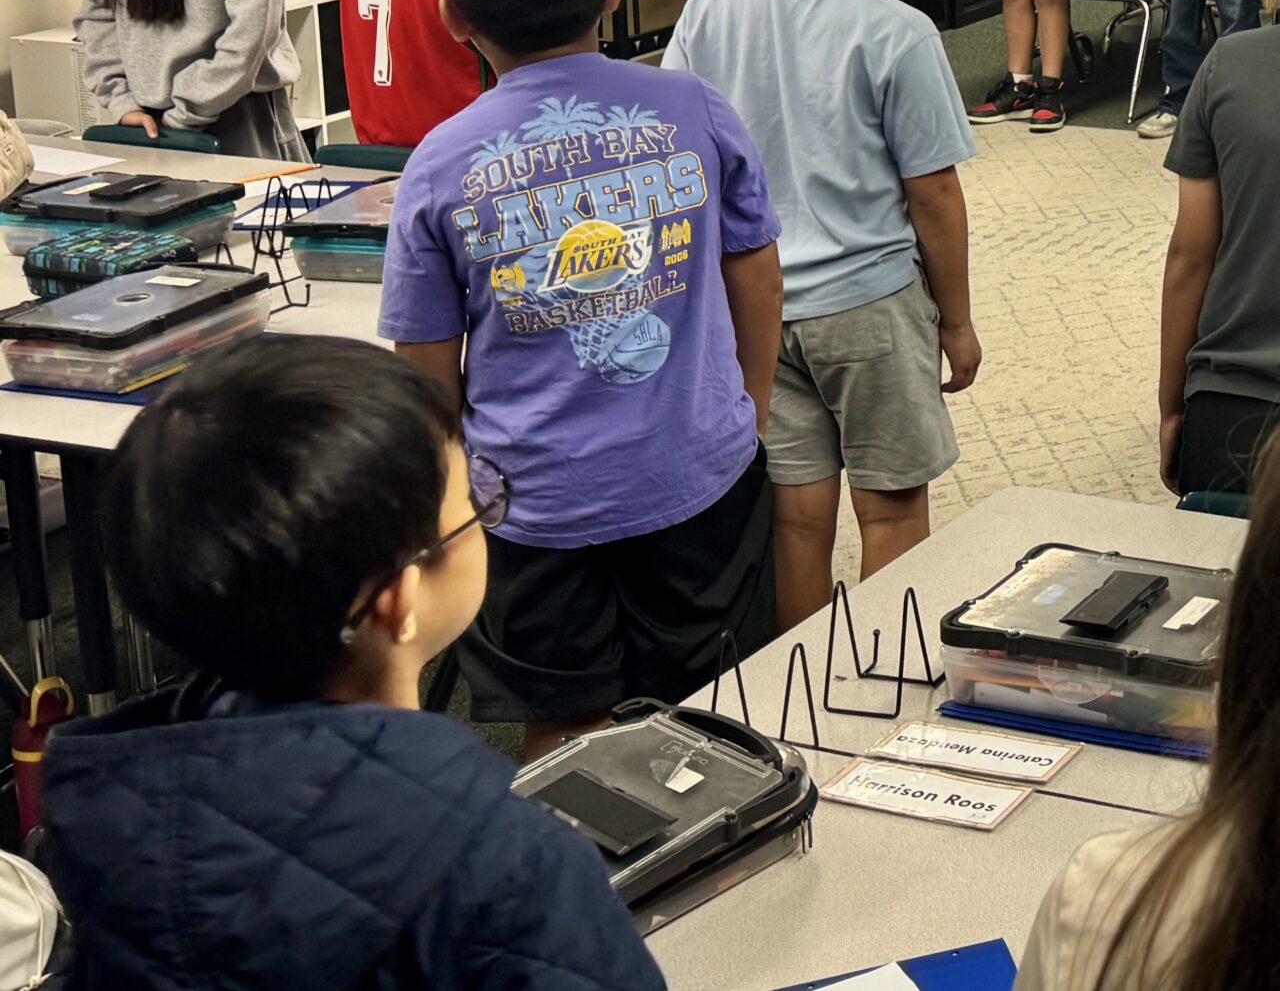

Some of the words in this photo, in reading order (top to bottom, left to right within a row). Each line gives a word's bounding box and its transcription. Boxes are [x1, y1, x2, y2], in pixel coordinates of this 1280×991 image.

[462, 132, 591, 203] SOUTH
[600, 124, 677, 159] BAY
[452, 151, 708, 262] LAKERS
[537, 240, 646, 293] LAKERS
[572, 239, 617, 254] SOUTH
[621, 230, 645, 243] BAY
[505, 270, 687, 334] BASKETBALL
[981, 747, 1054, 768] Caterina
[848, 775, 939, 802] Harrison
[943, 793, 997, 813] Roos
